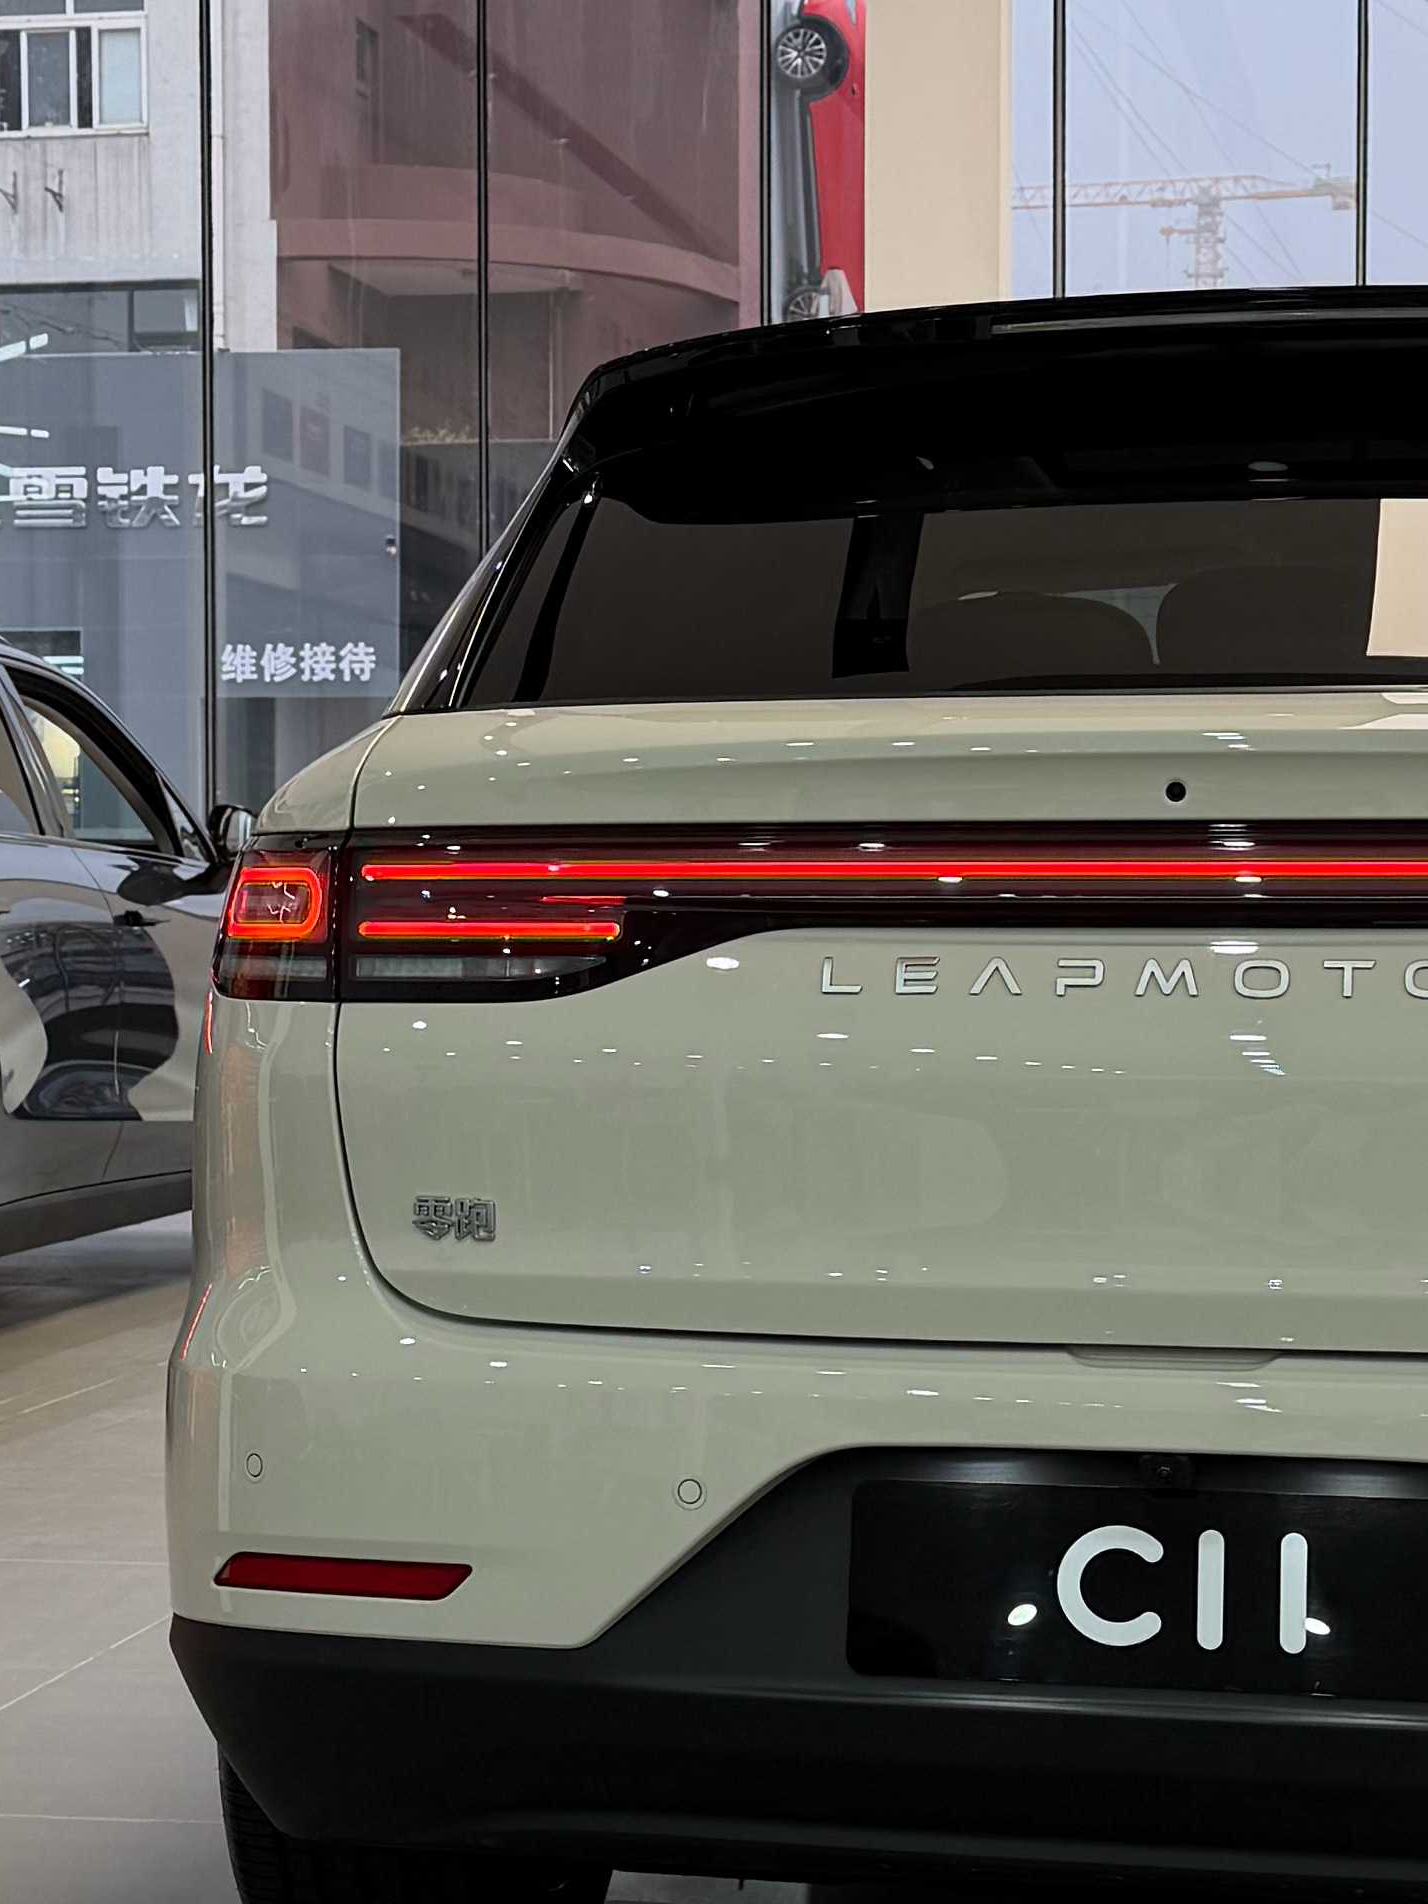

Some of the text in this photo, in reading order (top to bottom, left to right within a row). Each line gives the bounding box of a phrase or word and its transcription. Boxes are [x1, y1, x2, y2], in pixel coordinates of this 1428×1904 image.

[220, 641, 377, 684] 维修接待
[412, 1194, 497, 1243] 零跑
